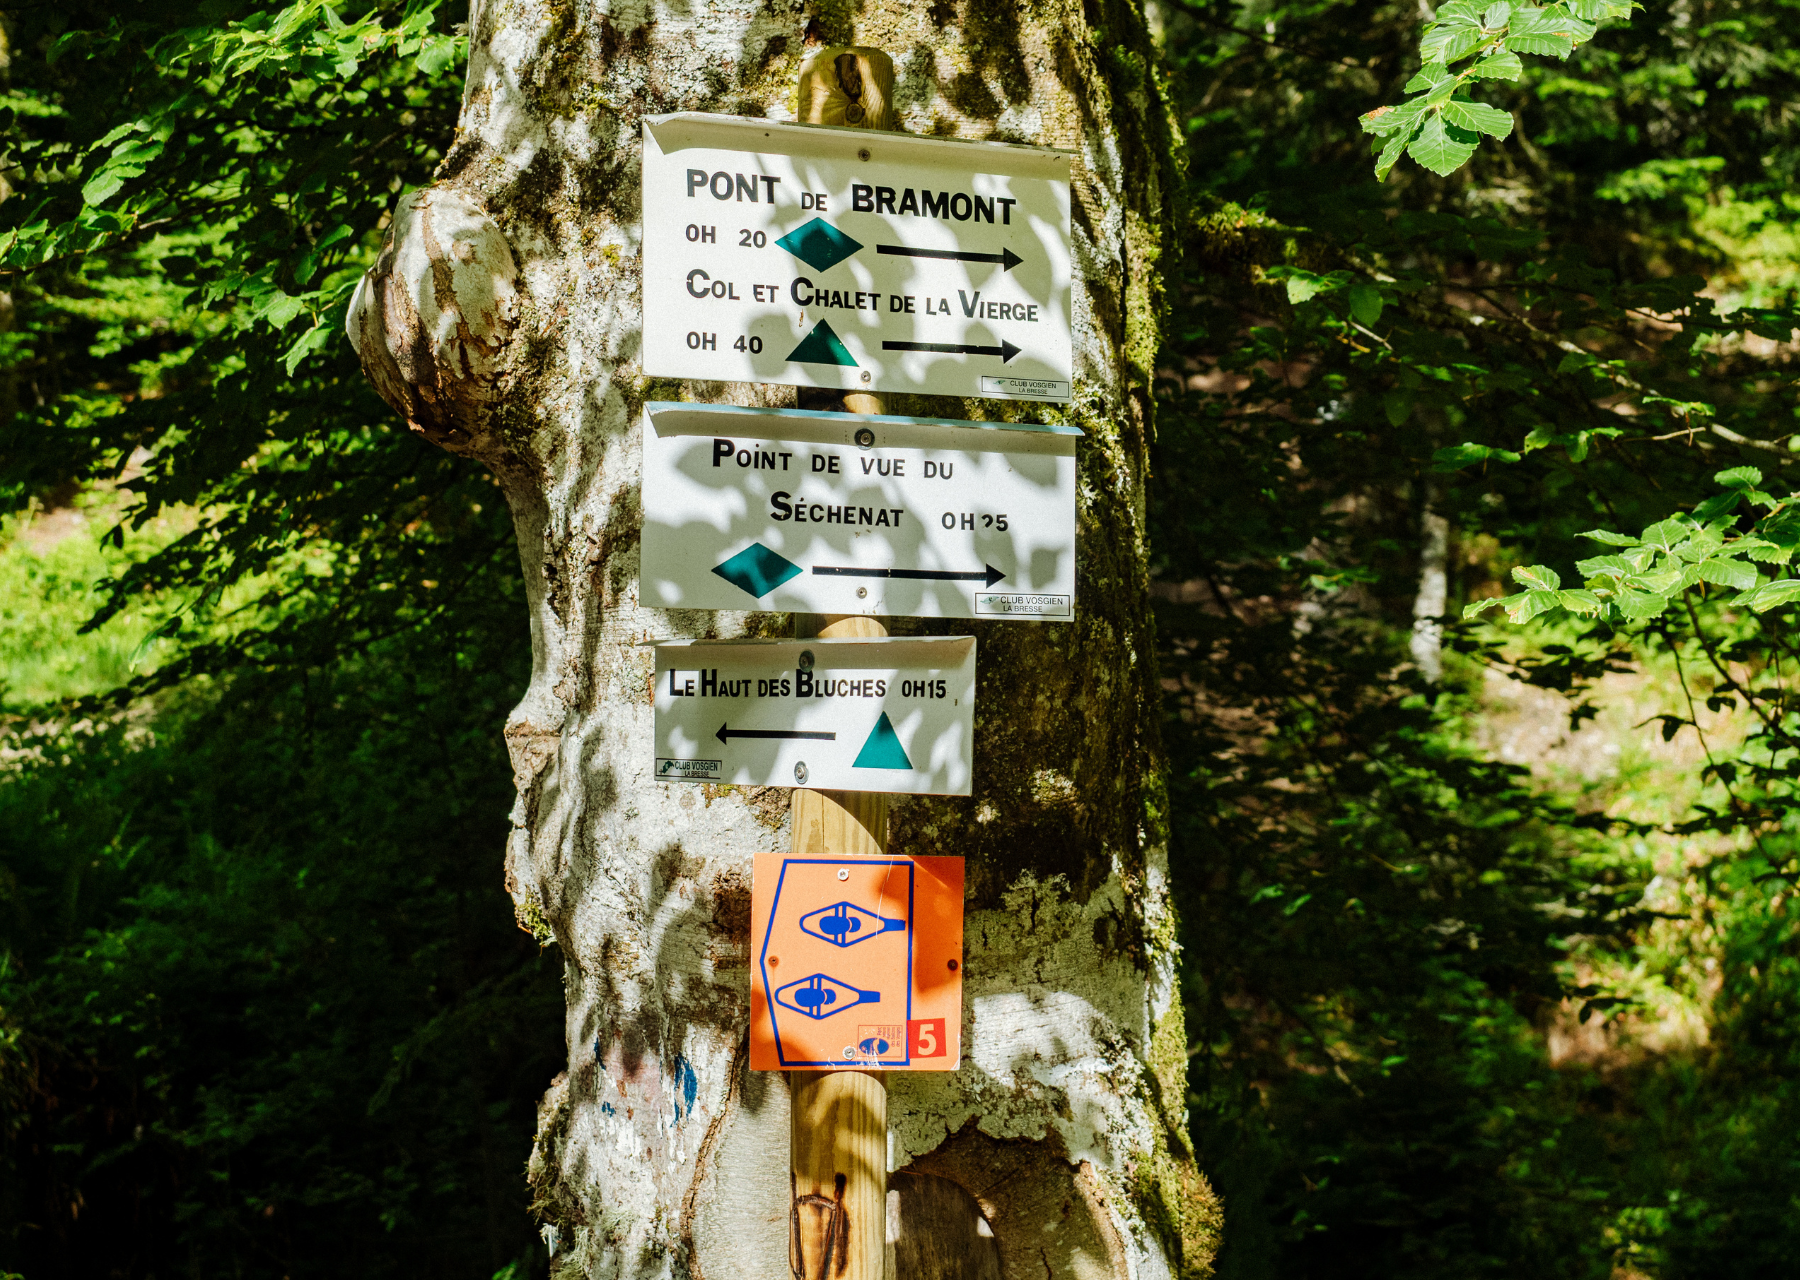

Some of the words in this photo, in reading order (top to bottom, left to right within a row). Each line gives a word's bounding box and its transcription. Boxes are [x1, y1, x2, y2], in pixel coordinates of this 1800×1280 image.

[687, 169, 781, 204] PONT
[802, 192, 827, 211] DE
[852, 184, 1016, 225] BRAMONT
[739, 229, 766, 248] 20
[753, 285, 779, 303] ET
[890, 295, 915, 313] DE
[926, 298, 951, 315] LA
[733, 335, 763, 354] 40
[812, 454, 840, 474] DE
[861, 457, 905, 476] VUE
[924, 461, 952, 479] DU
[1001, 596, 1023, 604] CLUB
[1026, 597, 1063, 605] VOSGIEN
[758, 679, 790, 697] DES
[675, 761, 690, 770] CLUB
[692, 762, 718, 771] VOSGIEN
[918, 1024, 936, 1055] 5
